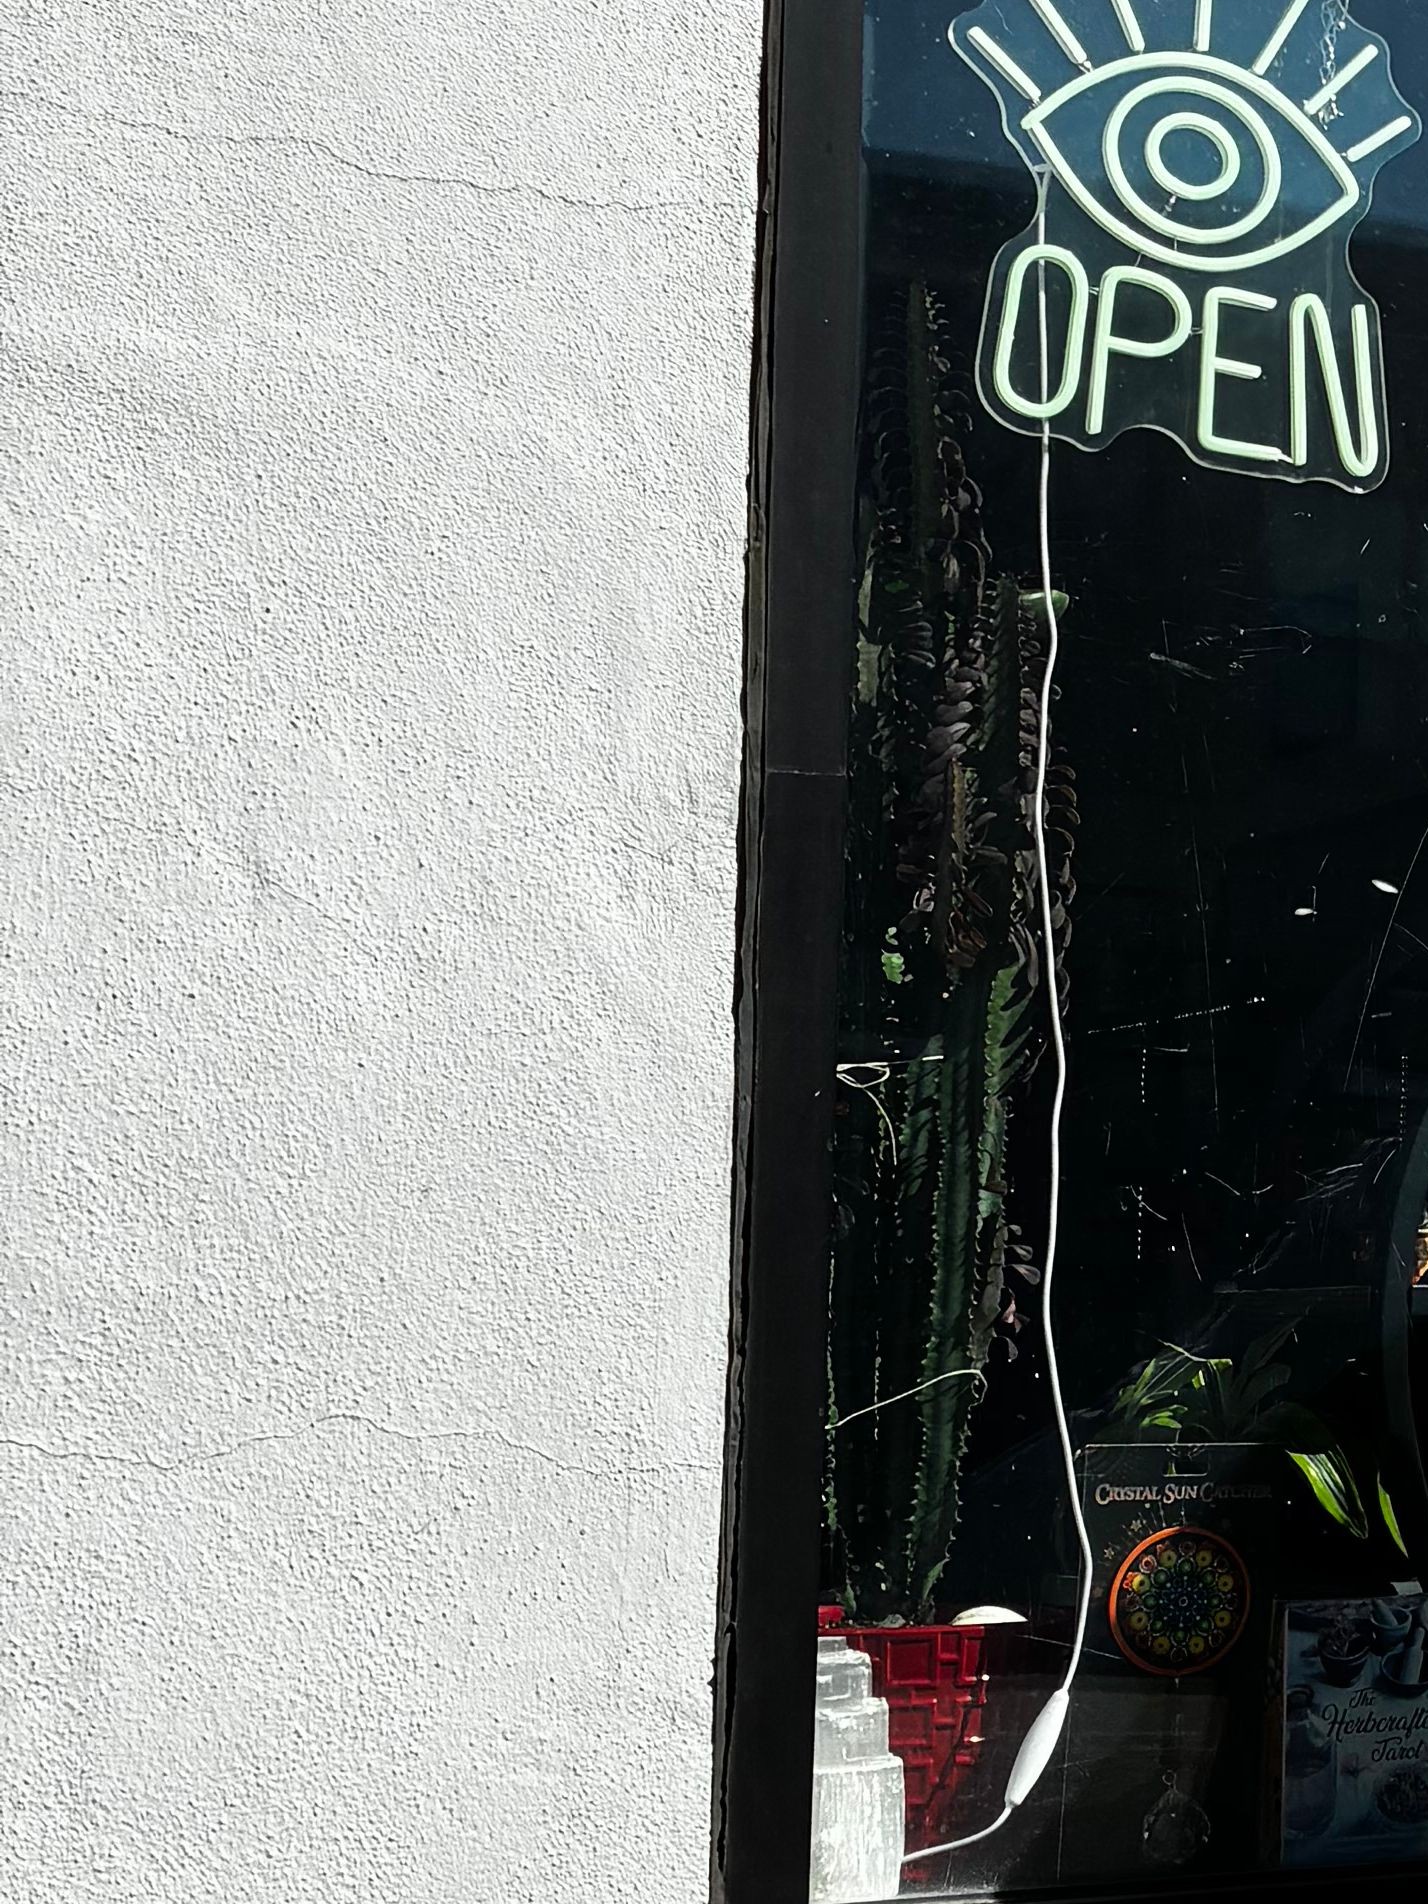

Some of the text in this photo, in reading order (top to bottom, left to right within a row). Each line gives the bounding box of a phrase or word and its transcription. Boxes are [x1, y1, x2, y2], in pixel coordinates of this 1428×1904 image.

[993, 243, 1379, 477] OPEN
[1095, 1483, 1161, 1505] CRYSTAL
[1163, 1483, 1198, 1504] SUN
[1348, 1688, 1376, 1708] The
[1371, 1737, 1424, 1762] Tarot
